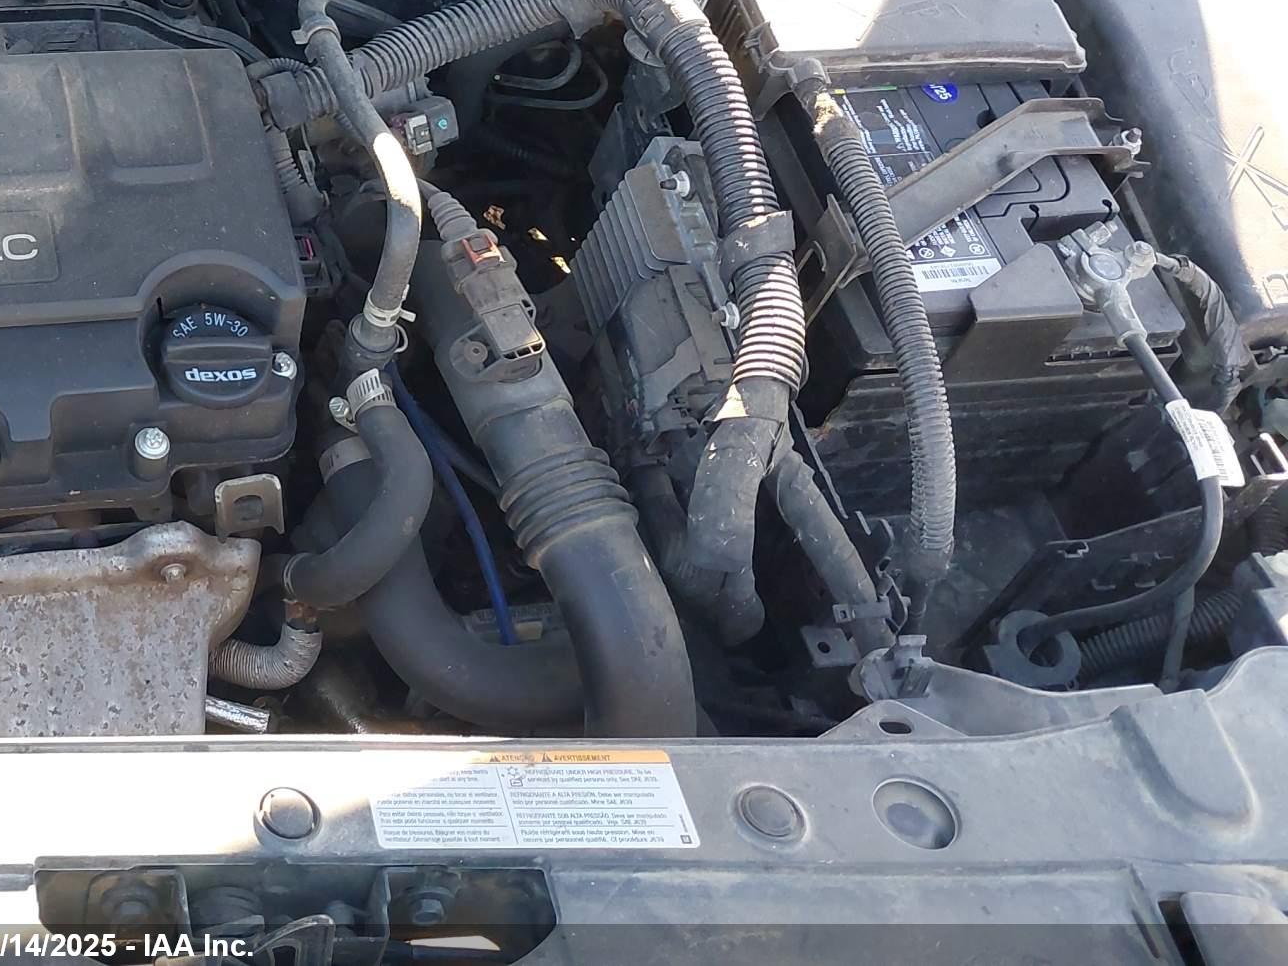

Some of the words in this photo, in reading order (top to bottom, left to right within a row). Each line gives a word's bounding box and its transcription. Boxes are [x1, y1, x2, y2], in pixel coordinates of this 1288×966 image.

[172, 315, 198, 339] SAE
[204, 312, 249, 338] 5W-30
[184, 367, 258, 383] dexos
